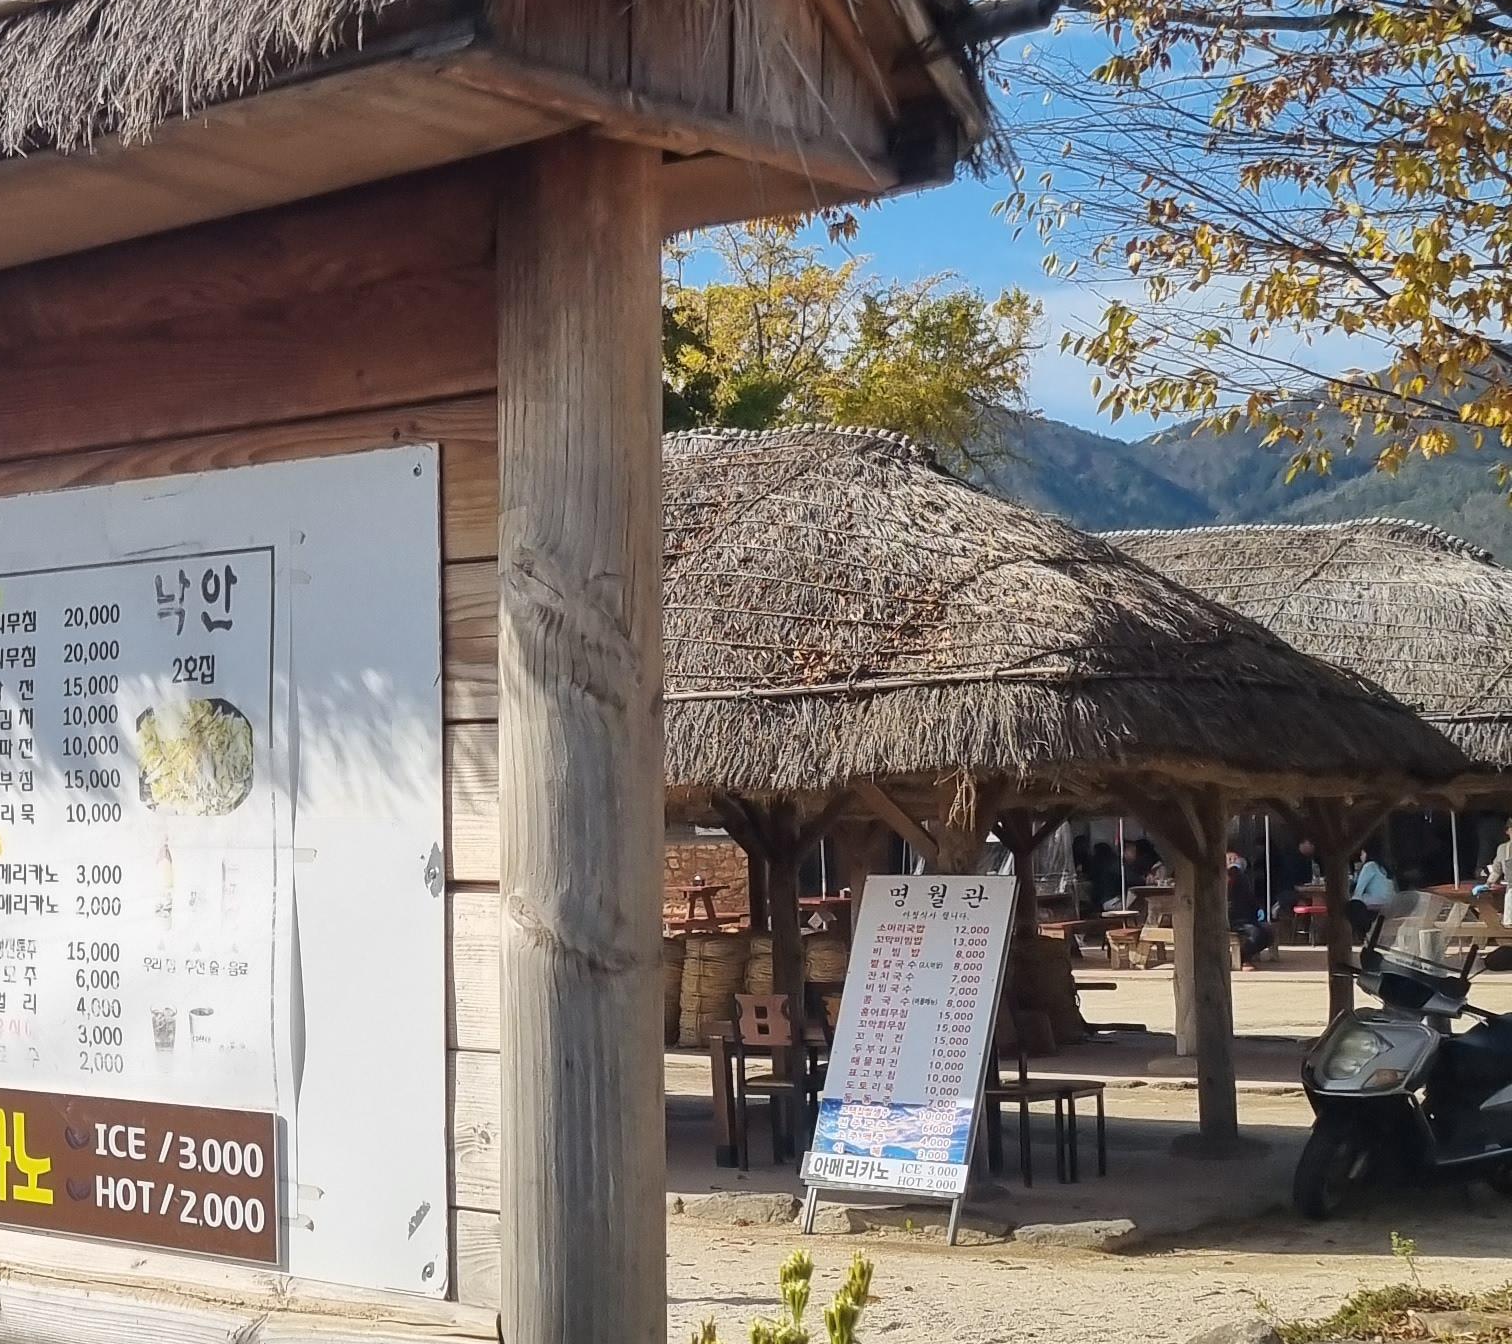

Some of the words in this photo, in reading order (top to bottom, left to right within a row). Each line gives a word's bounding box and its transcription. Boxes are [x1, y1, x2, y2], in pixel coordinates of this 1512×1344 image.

[155, 564, 238, 636] 낙안
[63, 604, 120, 630] 20,000
[63, 640, 120, 665] 20,000
[63, 674, 119, 699] 15,000
[63, 704, 119, 728] 10,000
[62, 735, 119, 758] 10,000
[64, 768, 121, 792] 15,000
[66, 803, 121, 826] 10,000
[76, 864, 122, 887] 3,000
[75, 895, 122, 918] 2,000
[955, 926, 990, 935] 12,000
[952, 938, 987, 947] 13,000
[67, 942, 120, 963] 15,000
[955, 950, 985, 959] 8,000
[953, 962, 983, 971] 8,000
[76, 969, 120, 991] 6,000
[951, 975, 980, 984] 7,000
[949, 987, 978, 996] 7,000
[76, 997, 122, 1020] 4,000
[946, 999, 976, 1009] 8,000
[939, 1011, 973, 1021] 15,000
[78, 1025, 123, 1048] 3,000
[934, 1036, 969, 1046] 15,000
[931, 1049, 967, 1059] 10,000
[79, 1051, 124, 1074] 2,000
[929, 1061, 964, 1071] 10,000
[927, 1074, 962, 1084] 10,000
[925, 1086, 959, 1096] 10,000
[928, 1099, 957, 1109] 7,000
[919, 1112, 955, 1122] 10,000
[922, 1124, 952, 1135] 6,000
[94, 1122, 147, 1161] ICE
[921, 1137, 950, 1147] 4,000
[918, 1150, 947, 1160] 3,000
[813, 1157, 888, 1180] 아메리카노
[901, 1163, 922, 1175] ICE
[927, 1165, 958, 1178] 3,000
[897, 1177, 923, 1188] HOT
[95, 1176, 155, 1214] HOT
